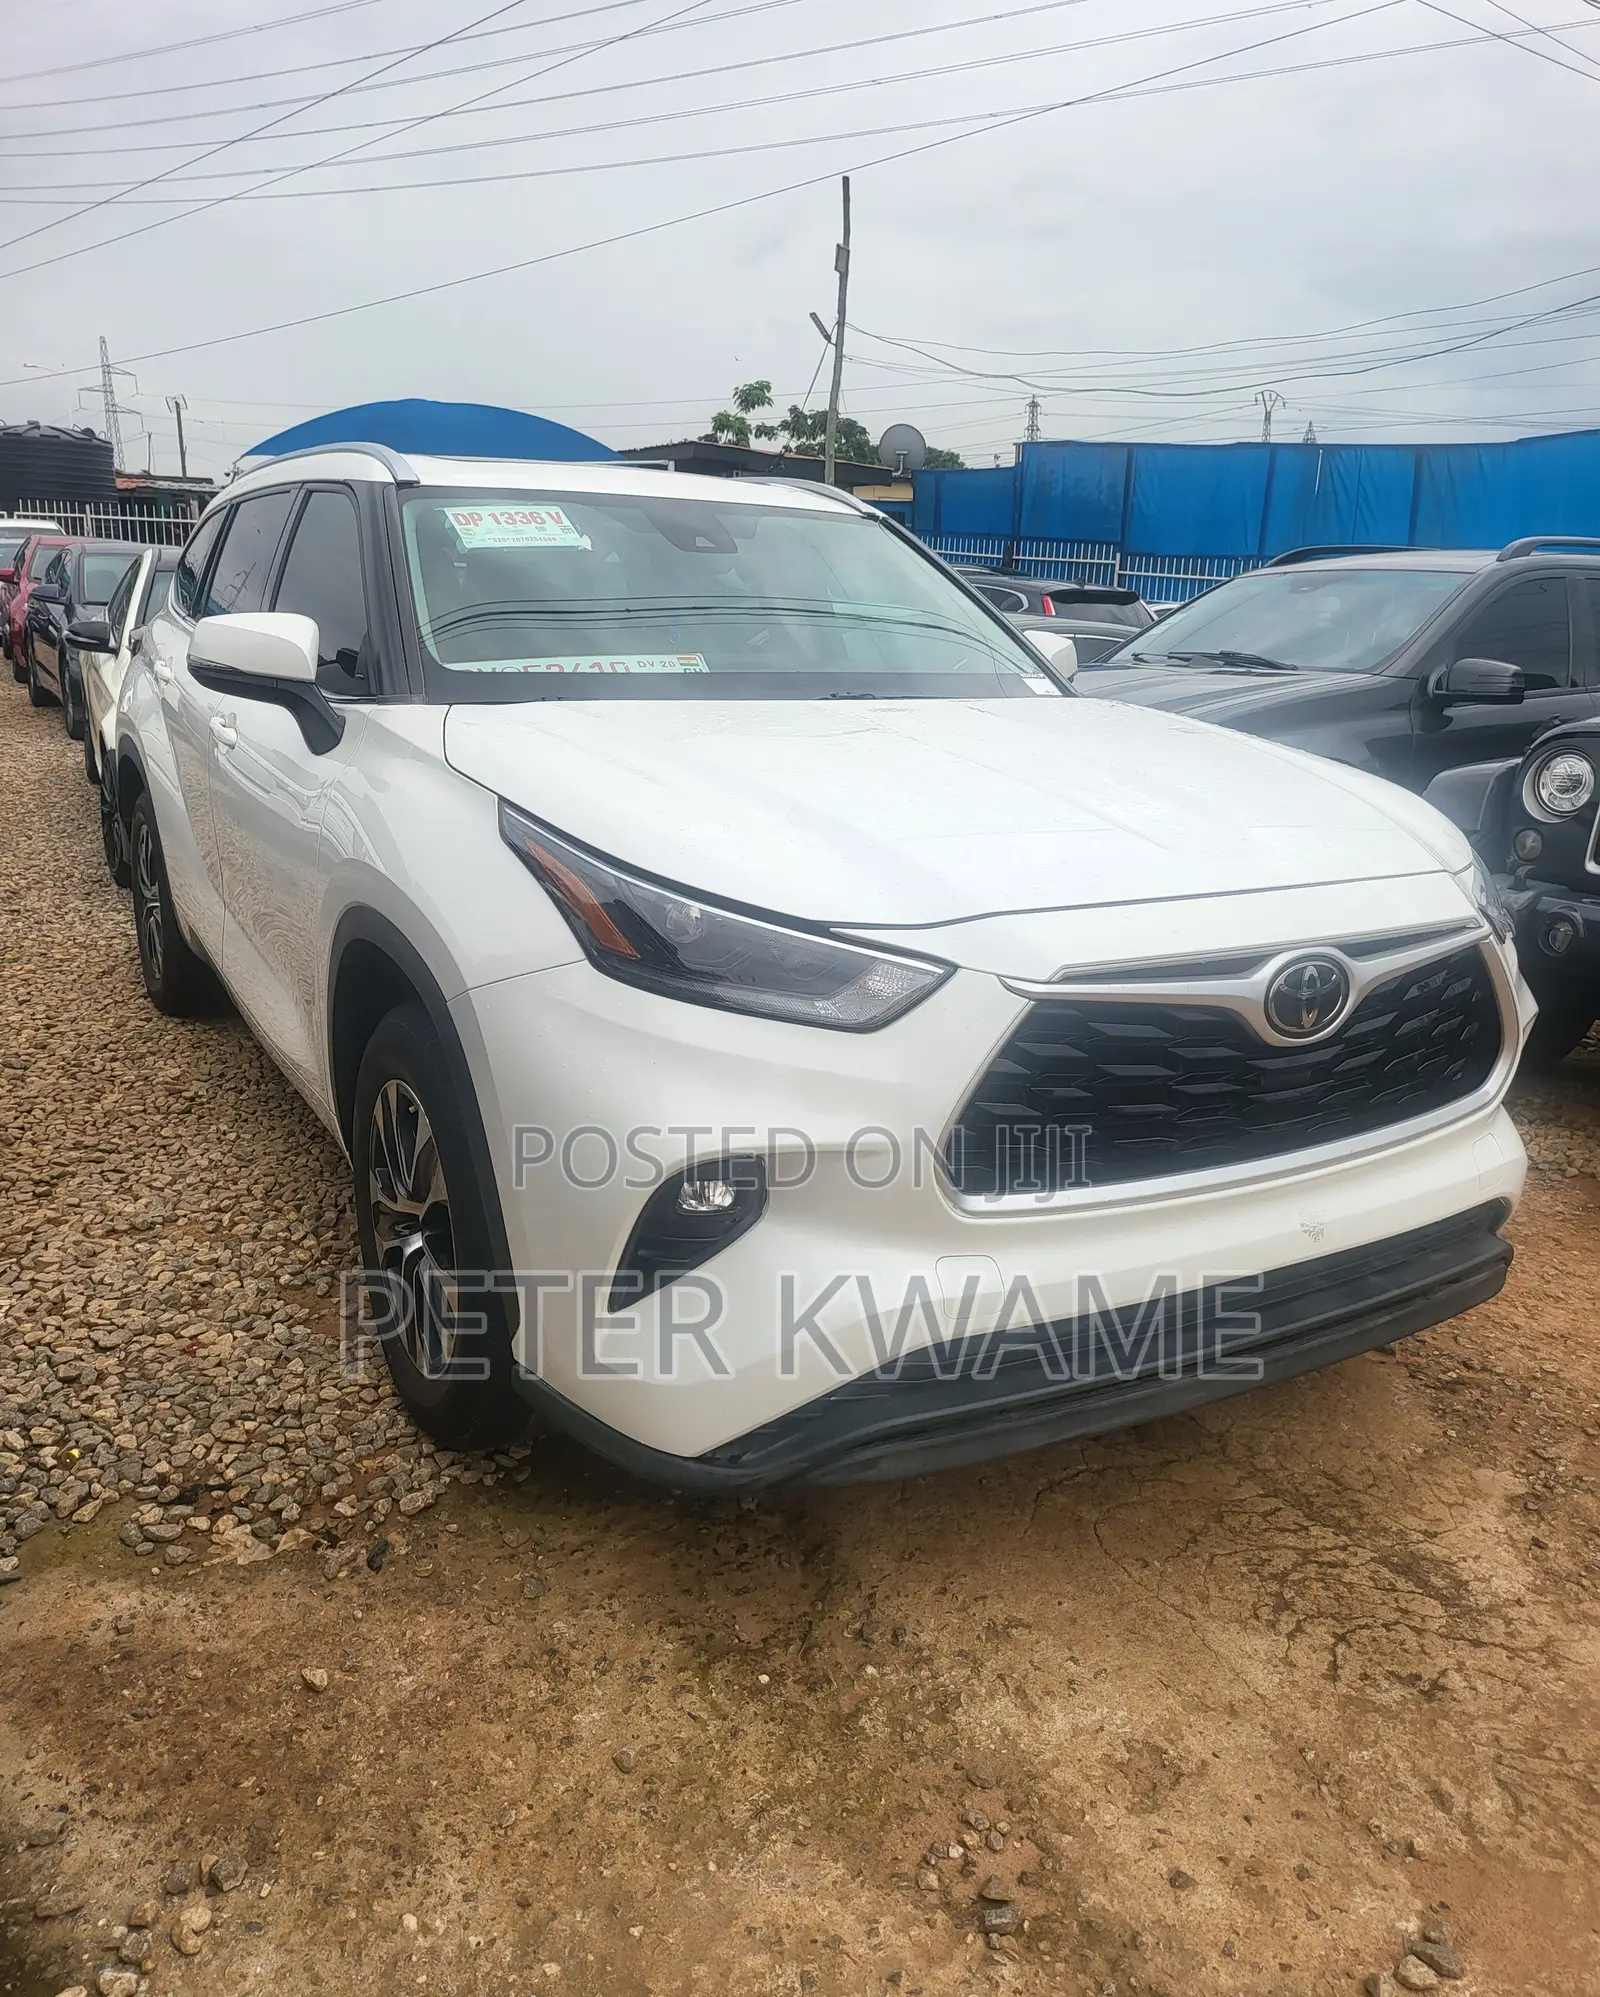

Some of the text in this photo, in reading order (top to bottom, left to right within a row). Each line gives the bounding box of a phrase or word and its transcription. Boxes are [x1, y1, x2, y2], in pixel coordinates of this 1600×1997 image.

[451, 511, 564, 527] DP 1336 V
[637, 660, 655, 668] DV
[660, 660, 676, 668] 20
